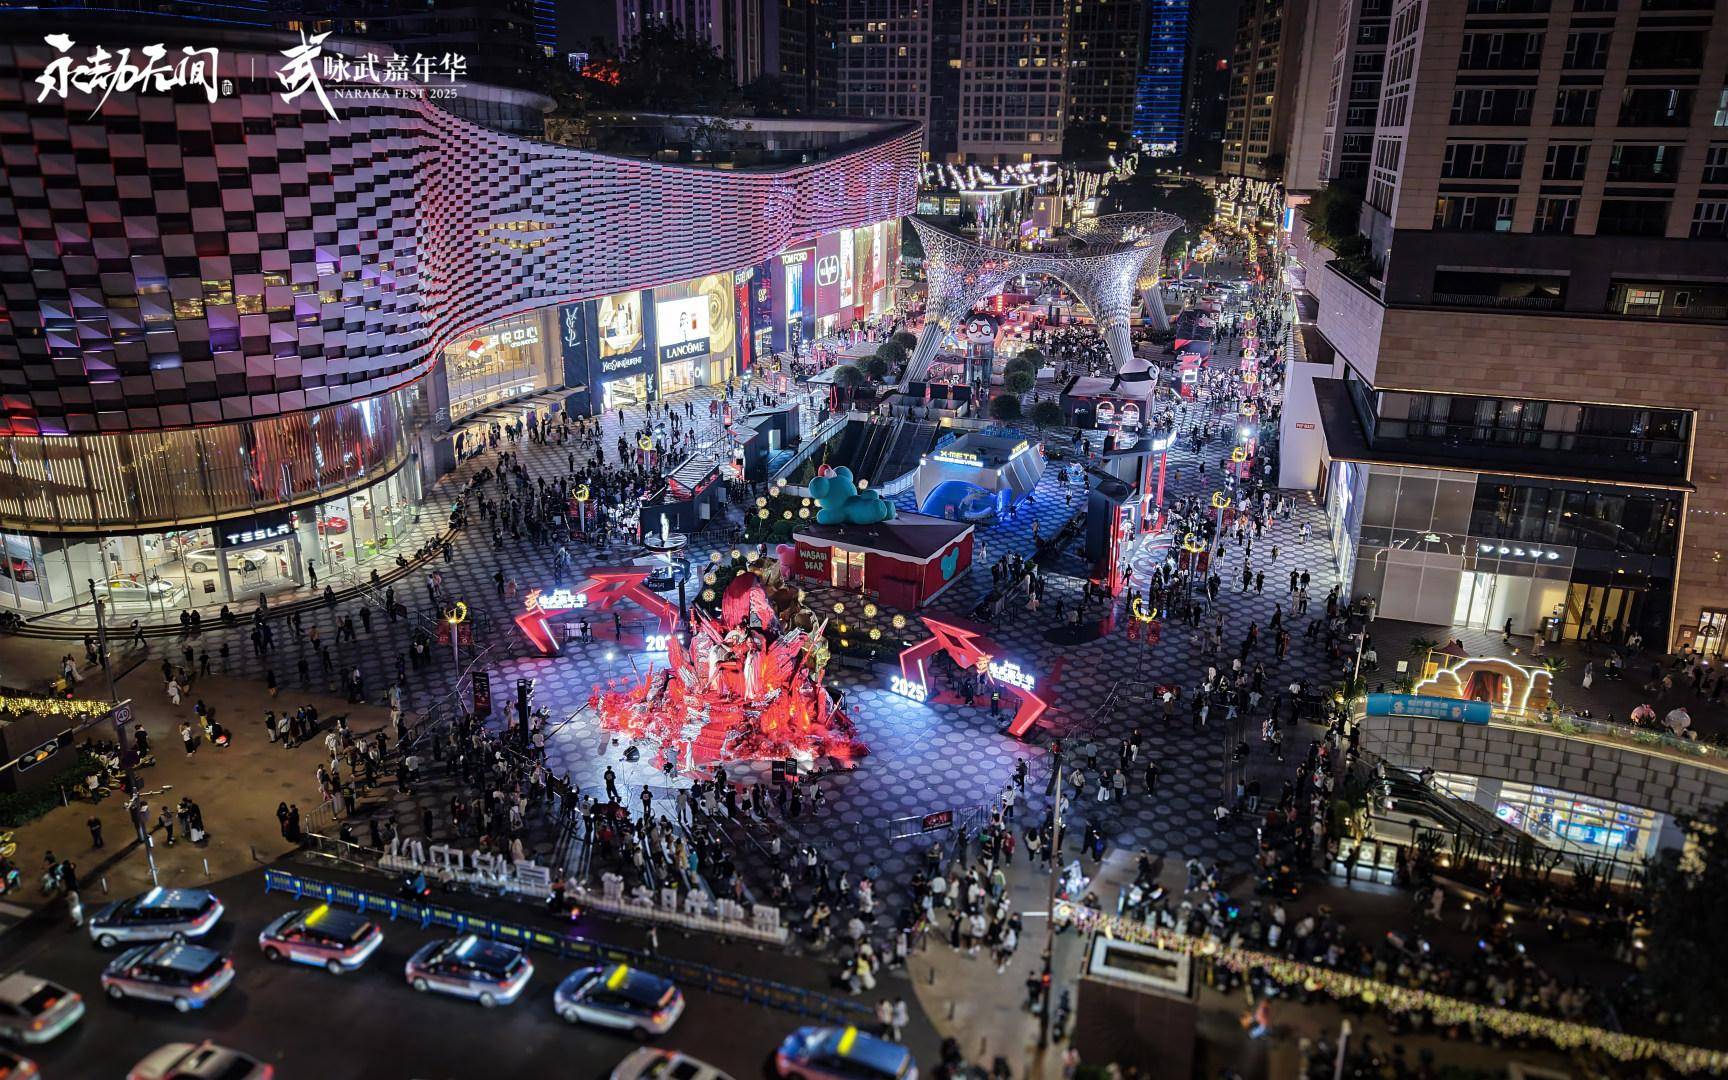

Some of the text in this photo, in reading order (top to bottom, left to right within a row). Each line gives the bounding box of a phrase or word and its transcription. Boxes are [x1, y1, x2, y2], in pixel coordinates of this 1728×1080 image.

[666, 341, 705, 359] LANCÔME
[226, 523, 290, 545] TESLA
[800, 549, 828, 561] WASABI
[1480, 545, 1560, 560] VOLVO
[804, 561, 824, 573] BEAR
[890, 675, 925, 702] 2025
